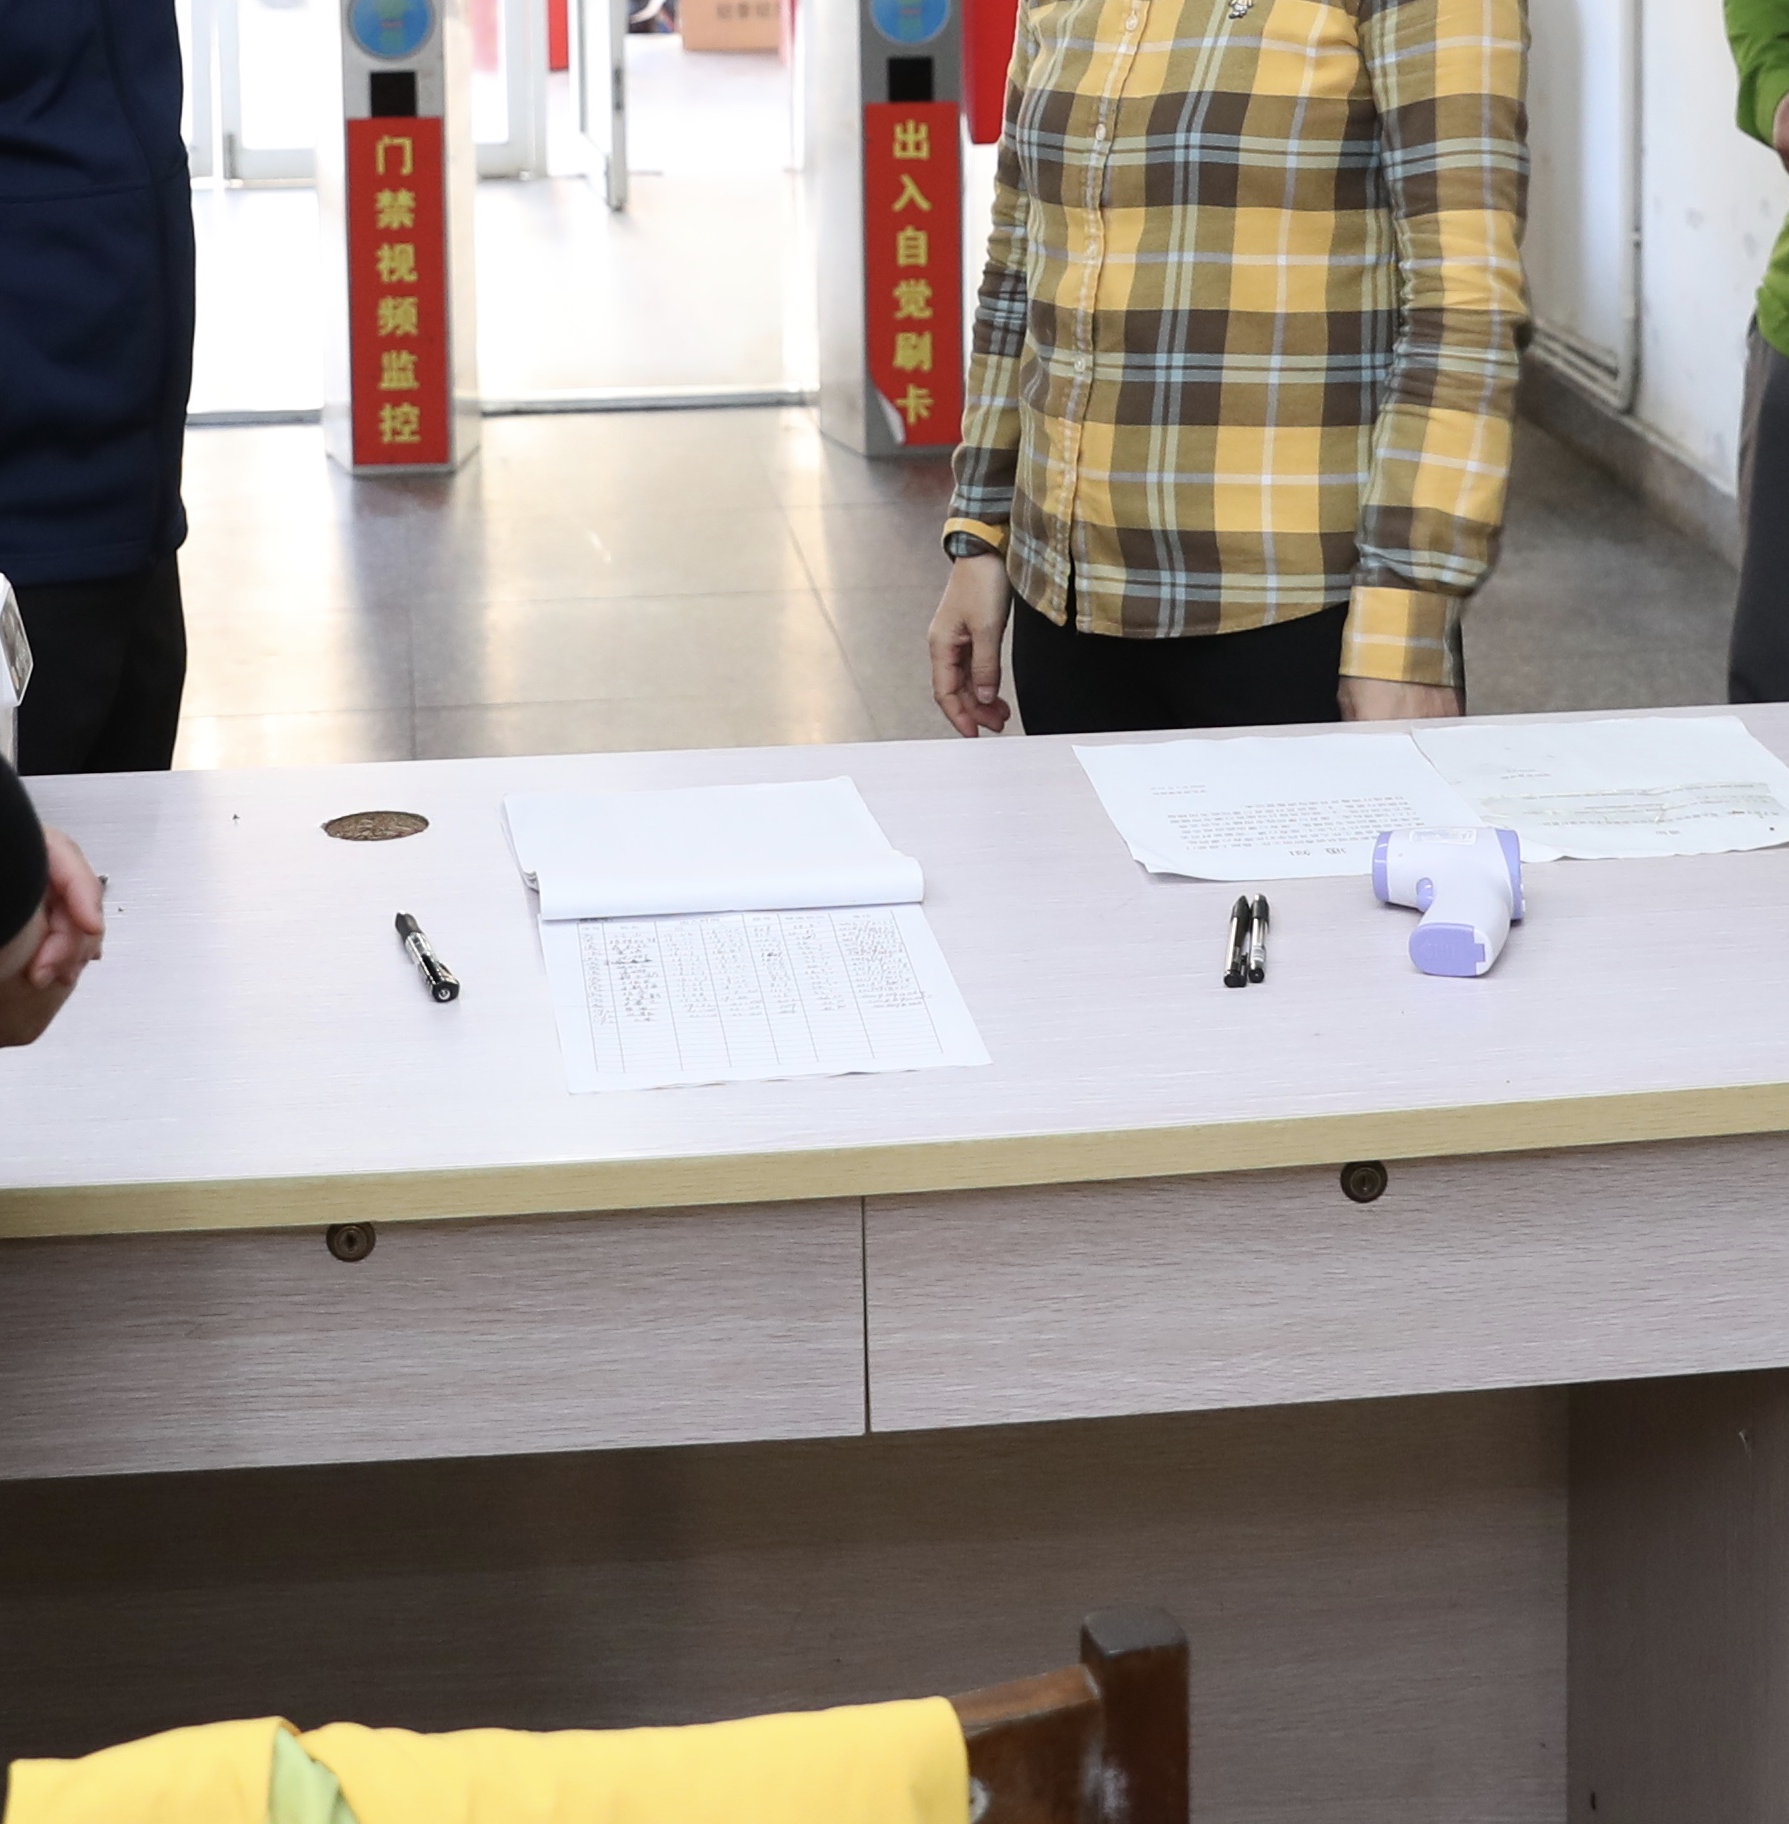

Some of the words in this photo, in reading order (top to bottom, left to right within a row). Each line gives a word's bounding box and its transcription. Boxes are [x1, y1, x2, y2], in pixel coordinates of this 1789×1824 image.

[375, 134, 421, 445] 门禁视频监控
[891, 120, 934, 426] 出入自觉刷卡
